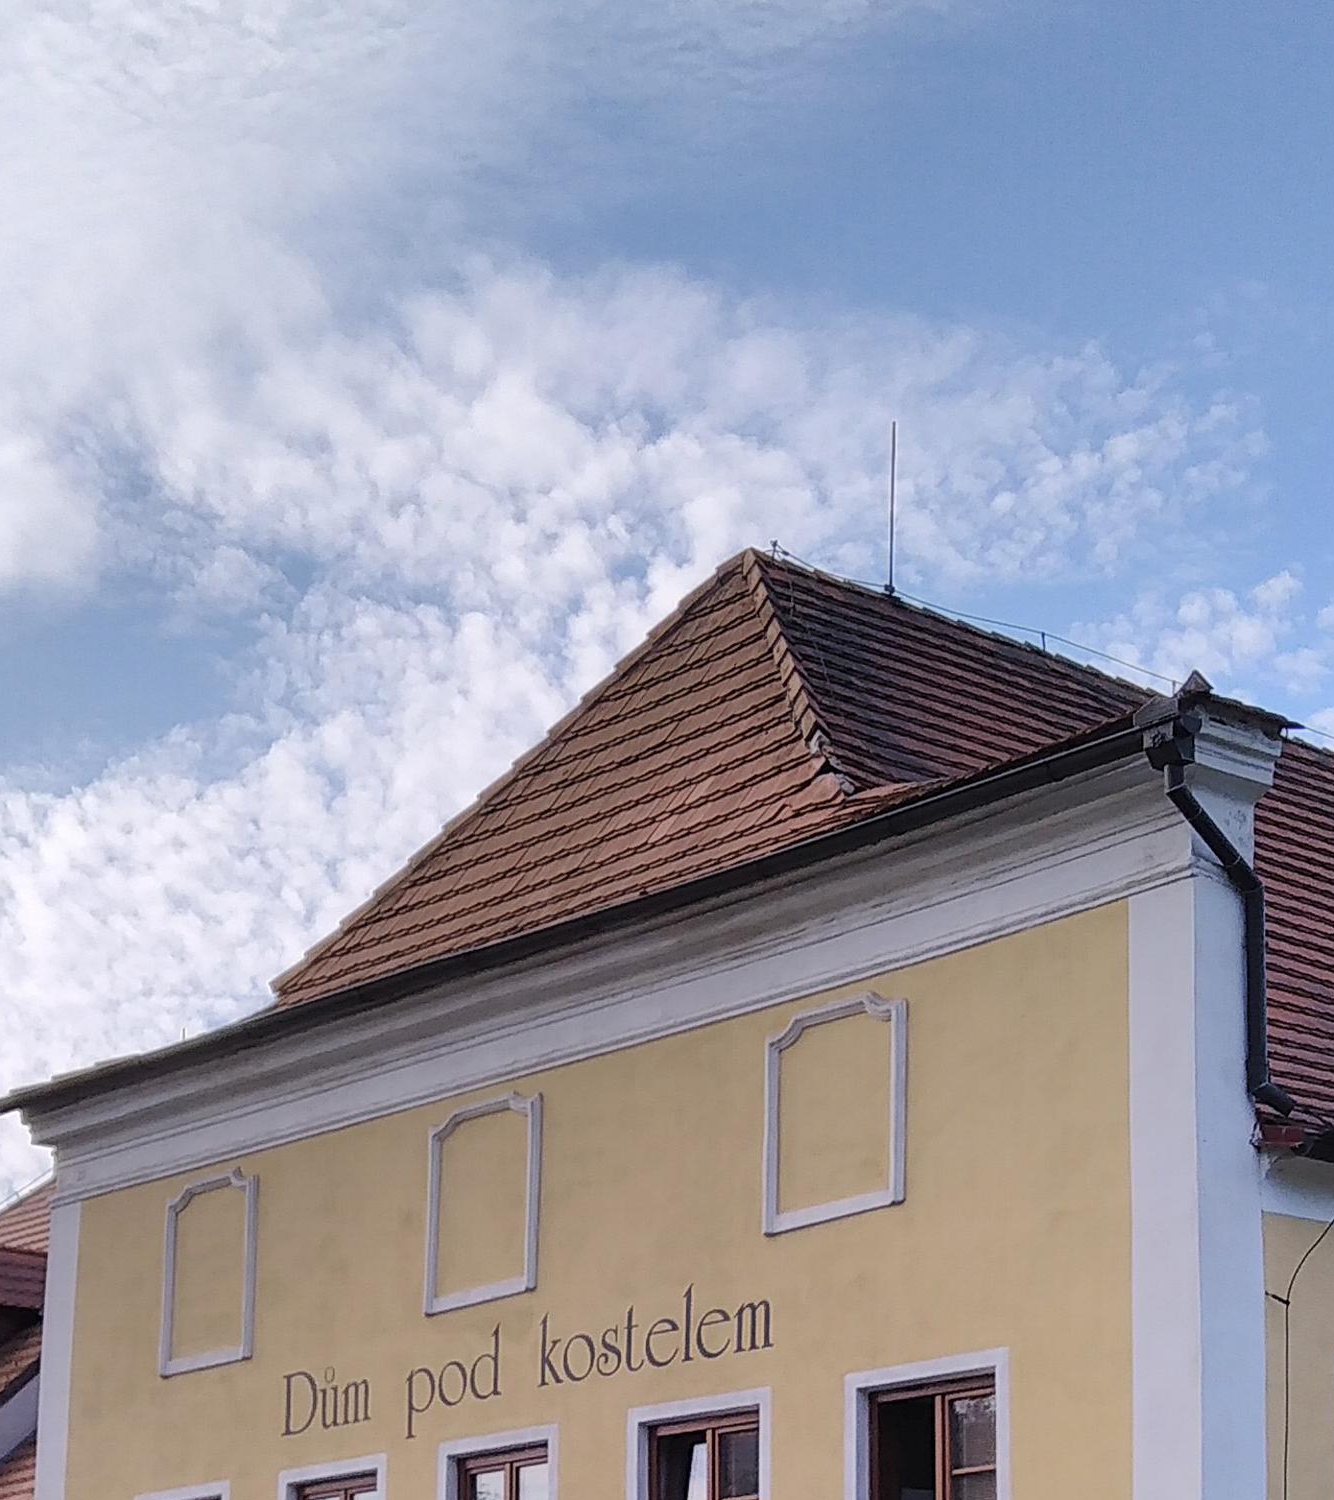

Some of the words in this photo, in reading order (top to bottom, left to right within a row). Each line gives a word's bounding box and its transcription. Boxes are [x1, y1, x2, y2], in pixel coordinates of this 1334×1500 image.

[280, 1365, 371, 1437] Dům
[405, 1323, 502, 1439] pod
[536, 1282, 775, 1389] kostelem
